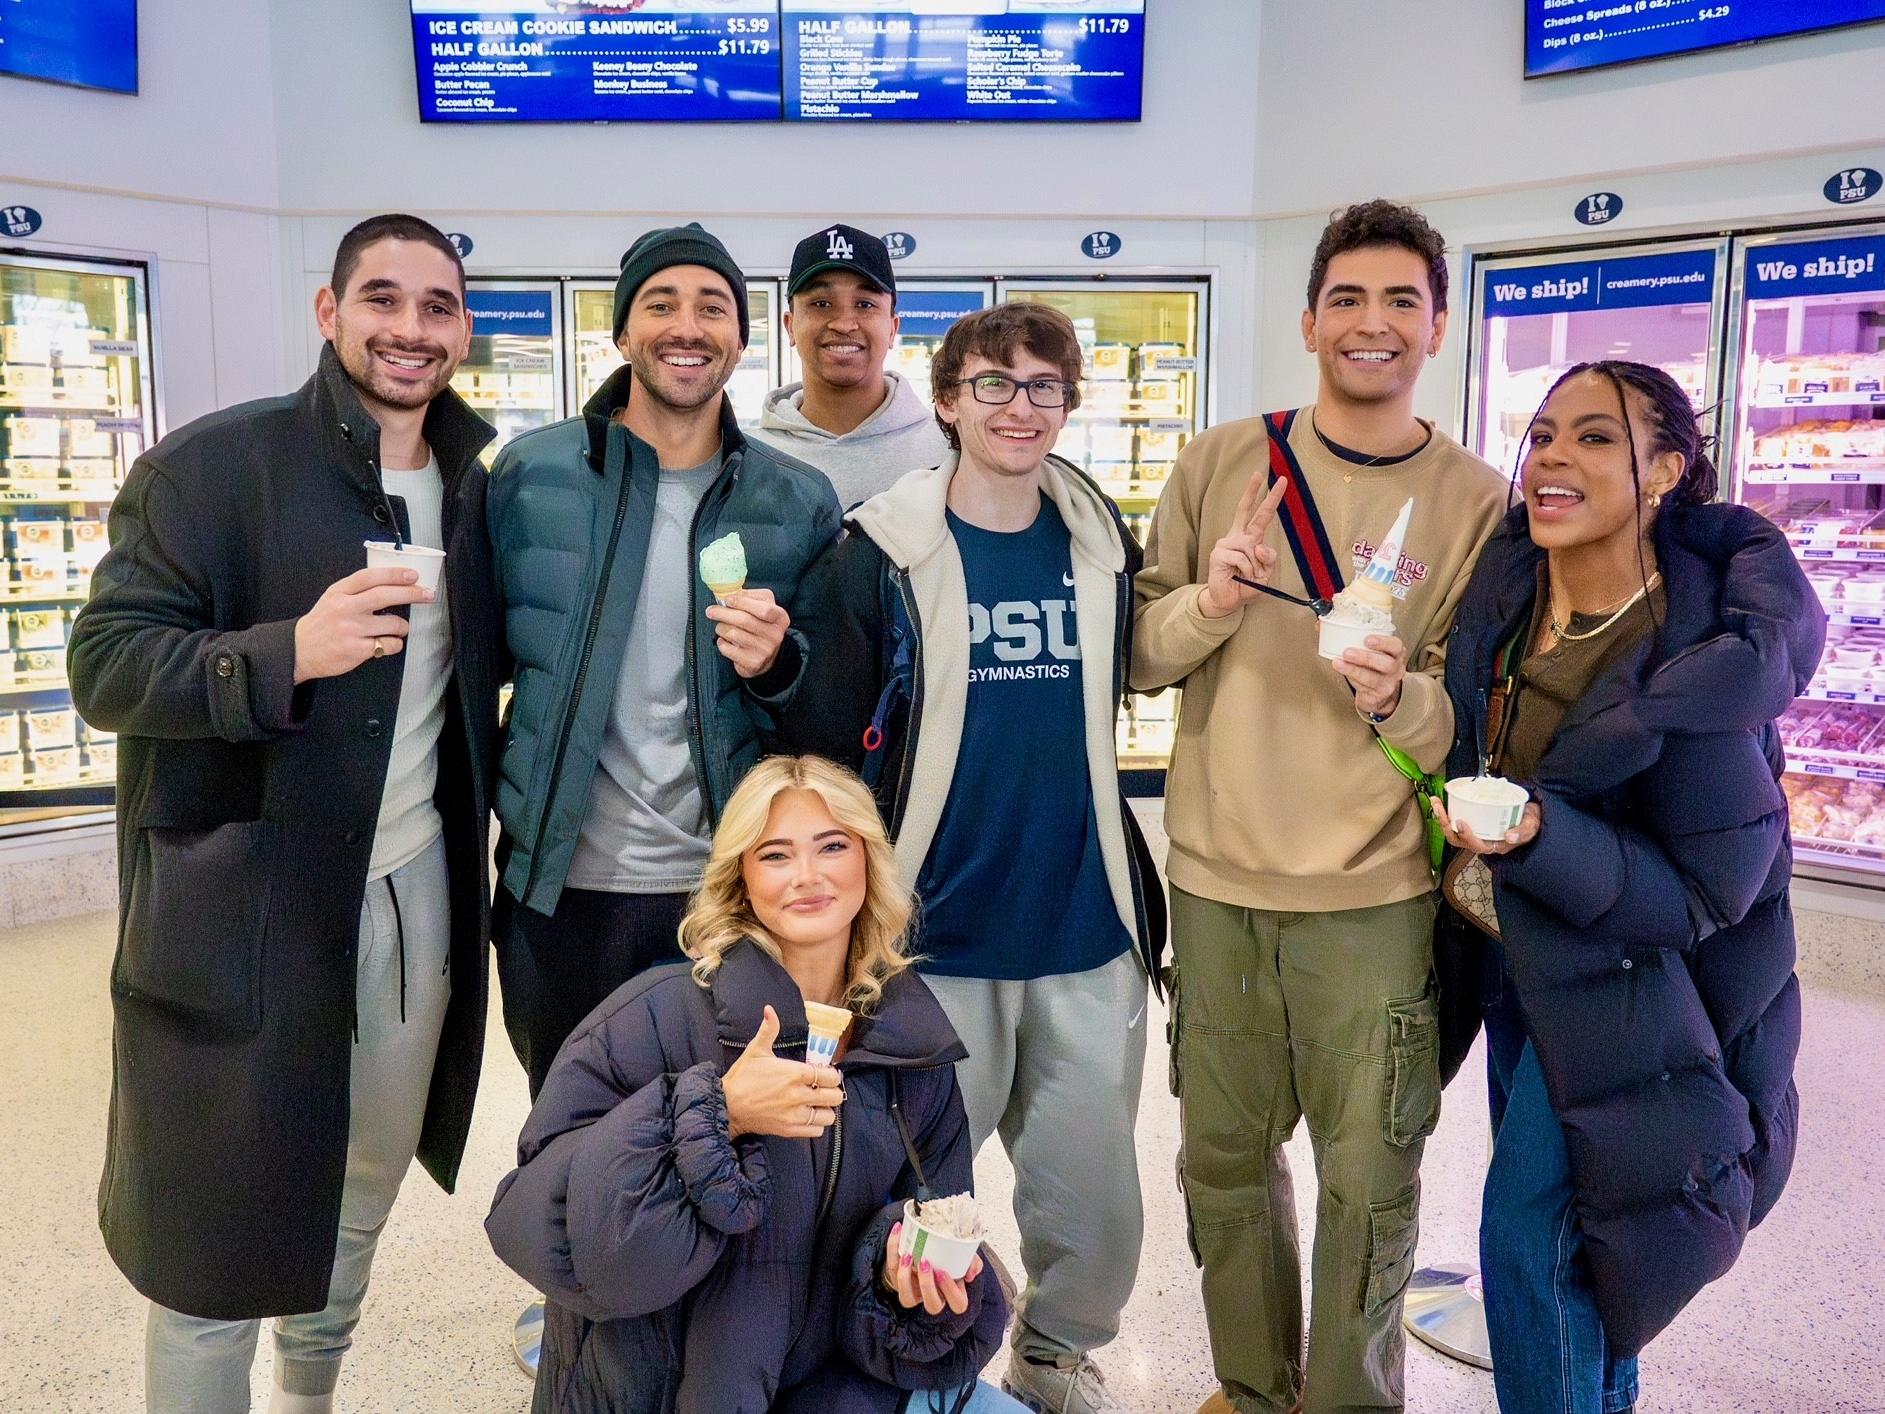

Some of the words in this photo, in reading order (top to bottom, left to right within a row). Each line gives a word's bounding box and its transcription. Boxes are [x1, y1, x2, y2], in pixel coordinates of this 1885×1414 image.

[1543, 15, 1584, 28] Cheese
[1586, 4, 1632, 21] Spreads
[429, 21, 457, 35] ICE
[460, 21, 518, 35] CREAM
[522, 21, 585, 35] COOKIE
[589, 21, 677, 35] SANDWICH
[727, 18, 769, 34] $5.99
[799, 21, 840, 34] HALF
[845, 21, 911, 34] GALLON
[1078, 18, 1129, 34] $11.79
[1543, 37, 1567, 48] Dips
[1583, 29, 1604, 41] oz.)
[1698, 6, 1730, 21] $4.29
[1007, 35, 1021, 44] Pie
[431, 43, 473, 56] HALF
[477, 43, 544, 56] GALLON
[718, 39, 770, 55] $11.79
[1012, 49, 1039, 59] Fudge
[433, 62, 459, 72] Apple
[460, 62, 496, 71] Cobbler
[496, 62, 528, 71] Crunch
[592, 61, 625, 72] Keeney
[625, 61, 653, 72] Beany
[654, 61, 698, 71] Chocolate
[800, 62, 832, 72] Orange
[967, 63, 993, 72] Salted
[996, 63, 1031, 72] Caramel
[435, 80, 462, 89] Butter
[464, 80, 490, 89] Pecan
[594, 79, 629, 90] Monkey
[630, 79, 668, 88] Business
[800, 77, 831, 86] Peanut
[832, 77, 859, 86] Butter
[860, 77, 879, 87] Cup
[1006, 77, 1026, 87] Chip
[800, 90, 831, 100] Peanut
[832, 90, 860, 100] Butter
[860, 90, 919, 100] Marshmallow
[967, 91, 993, 100] White
[994, 91, 1011, 99] Out
[436, 98, 473, 107] Coconut
[473, 98, 494, 109] Chip
[800, 104, 840, 113] Pistachio
[1840, 172, 1850, 189] I
[1840, 187, 1865, 199] PSU
[1587, 196, 1596, 212] I
[1588, 210, 1609, 221] PSU
[9, 222, 31, 233] PSU
[826, 229, 854, 259] LA
[1092, 234, 1099, 247] I
[1093, 247, 1110, 255] PSU
[1756, 261, 1798, 281] We
[1803, 253, 1875, 279] ship!
[1494, 284, 1527, 301] We
[1531, 277, 1589, 299] ship!
[1606, 272, 1705, 289] creamery.psu.edu
[472, 309, 545, 320] reamery.psu.edu
[968, 600, 1081, 661] PSU
[968, 664, 1070, 682] GYMNASTICS
